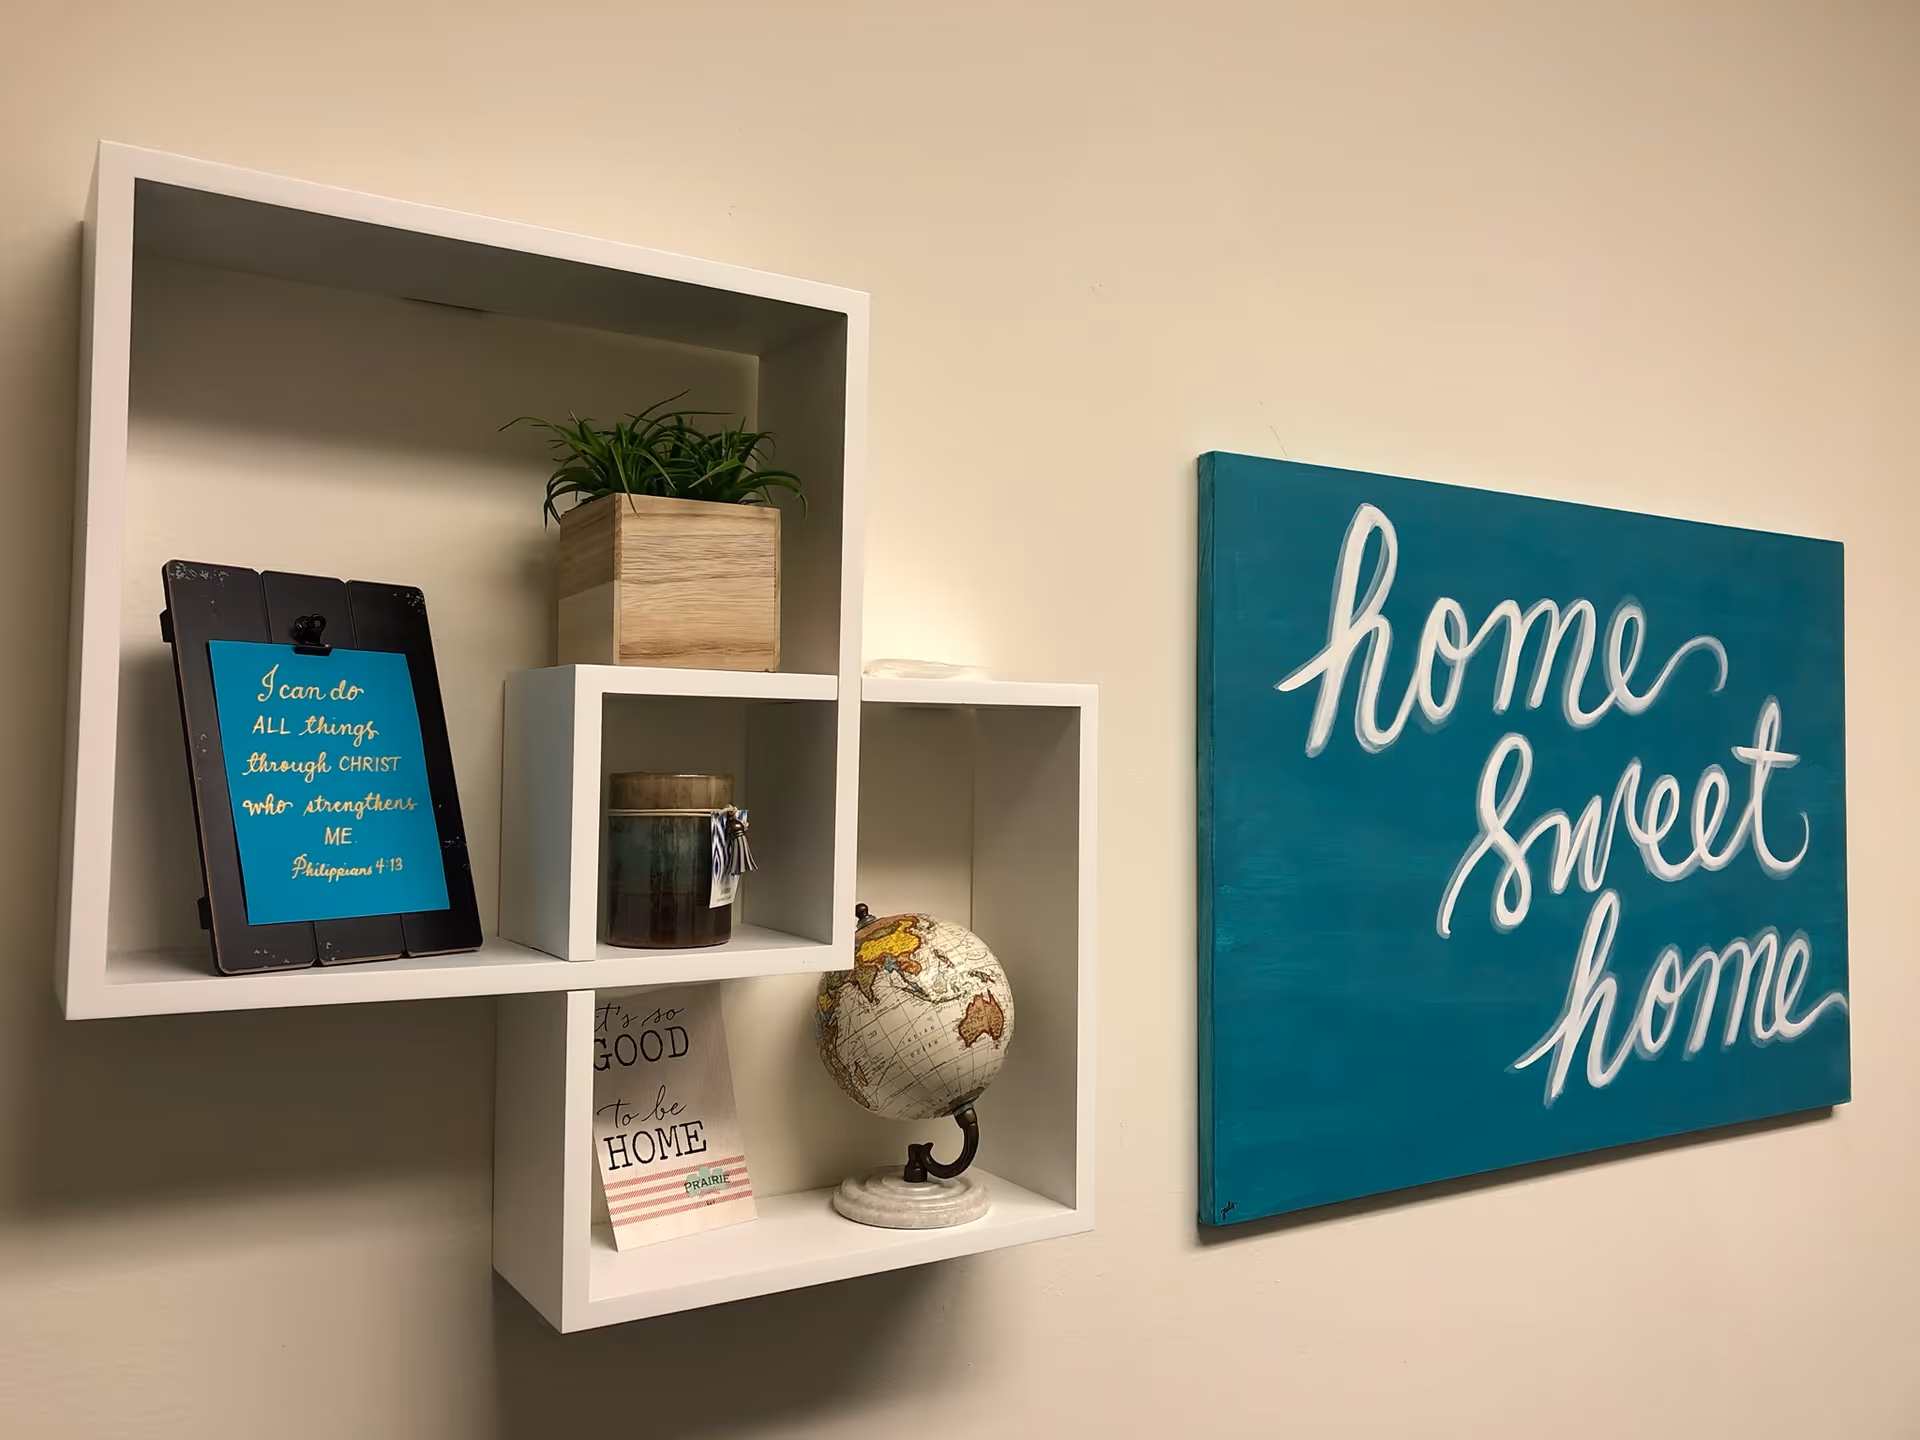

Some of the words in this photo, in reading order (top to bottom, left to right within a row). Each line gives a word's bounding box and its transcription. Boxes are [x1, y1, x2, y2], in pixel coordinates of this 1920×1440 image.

[1273, 502, 1729, 758] home
[257, 664, 280, 702] I
[279, 682, 327, 700] can
[330, 679, 365, 701] do
[251, 715, 291, 735] ALL
[298, 715, 379, 748] things
[241, 751, 332, 783] through
[338, 756, 402, 772] CHRIST
[241, 793, 293, 816] who
[302, 792, 418, 820] strengthens
[291, 853, 372, 883] Philippians
[375, 857, 403, 874] 4:13
[641, 1007, 686, 1027] so
[1505, 889, 1849, 1110] home
[594, 1025, 690, 1071] GOOD
[596, 1098, 640, 1129] to
[640, 1084, 688, 1122] be
[602, 1119, 708, 1171] HOME
[684, 1174, 731, 1193] PRAIRIE
